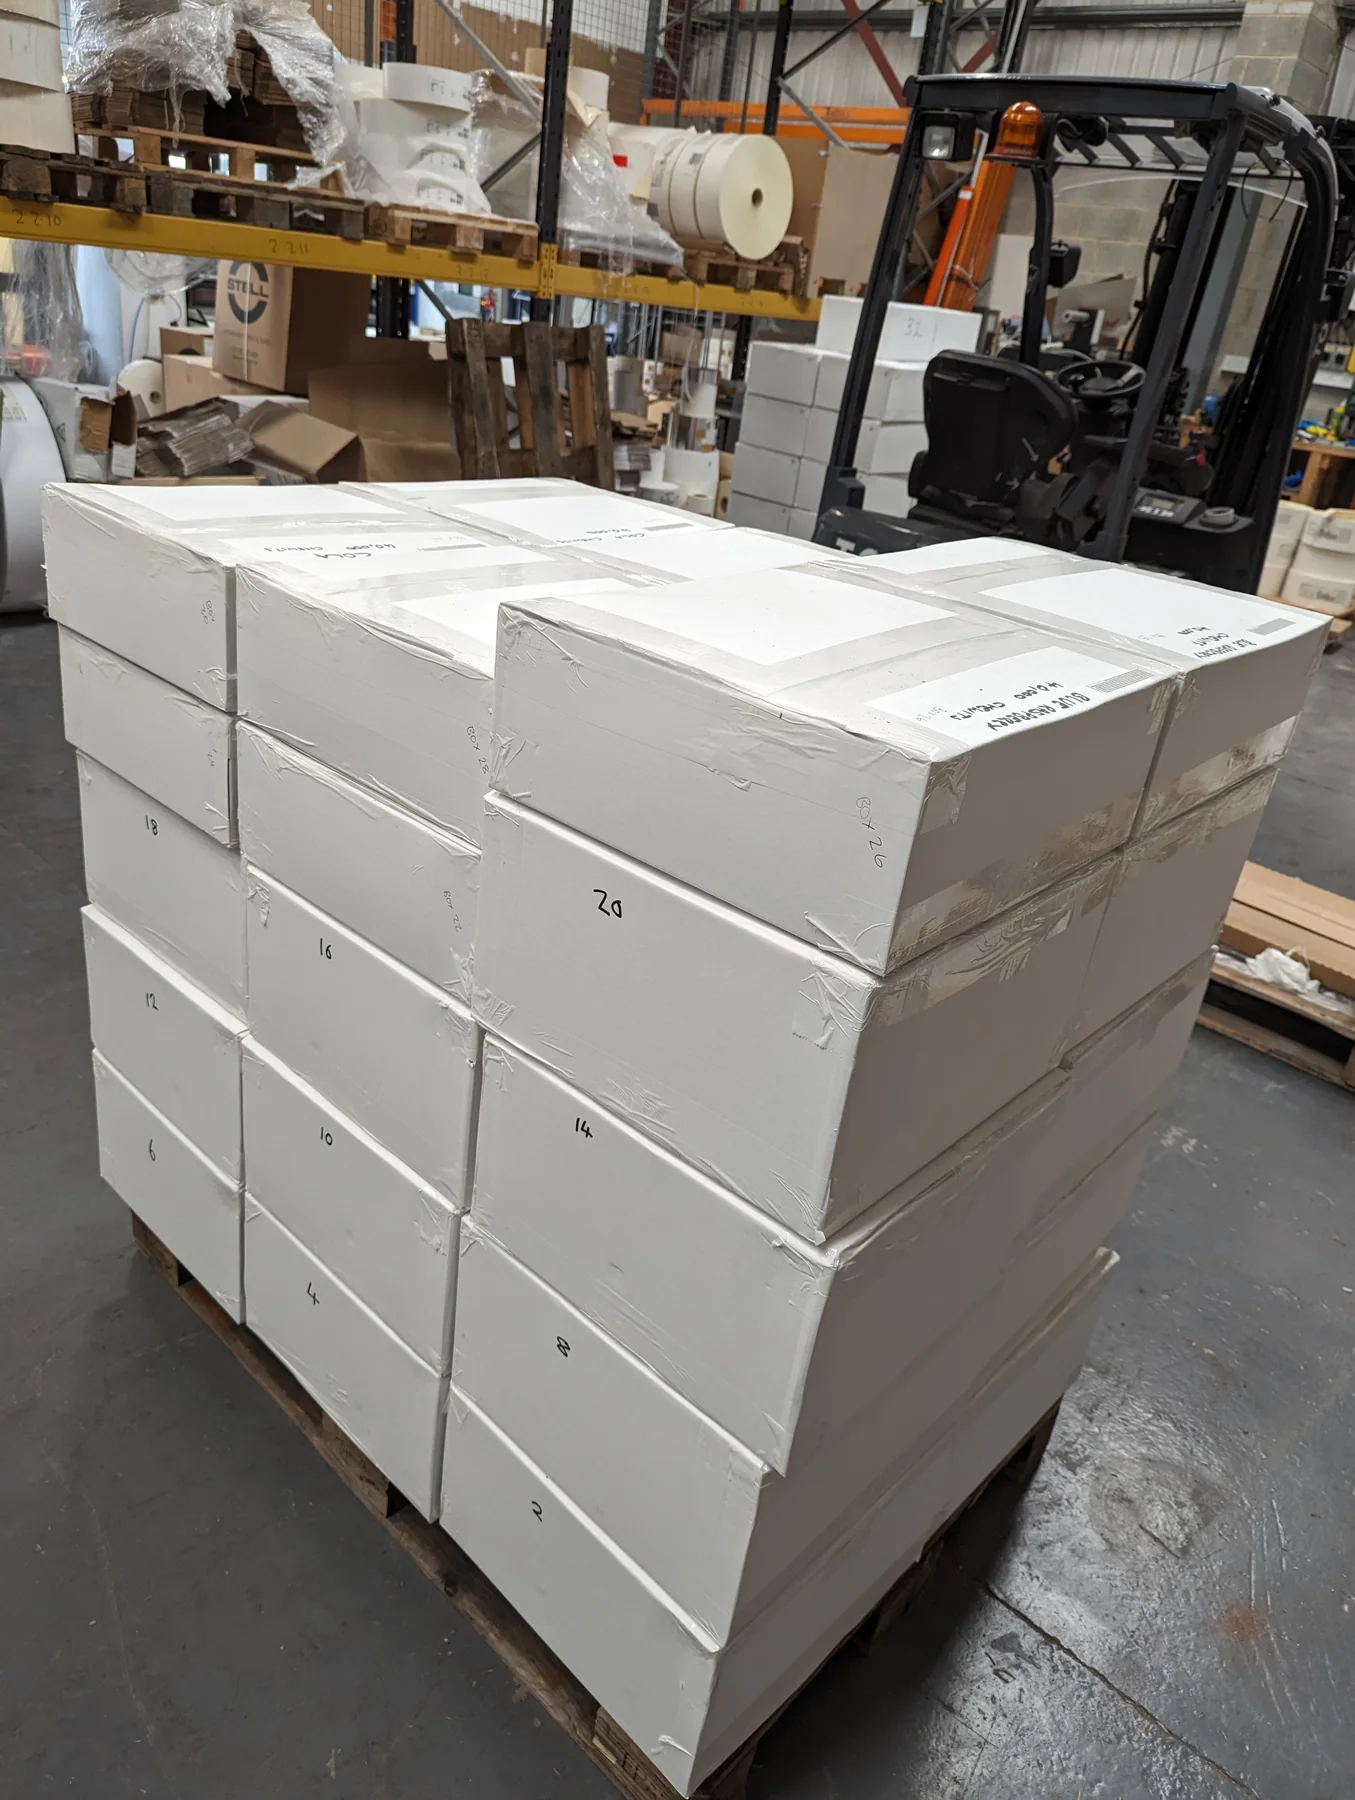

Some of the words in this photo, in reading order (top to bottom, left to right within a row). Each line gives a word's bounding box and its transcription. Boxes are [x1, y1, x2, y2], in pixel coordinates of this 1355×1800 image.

[313, 551, 372, 560] COLA
[345, 542, 397, 551] 40,000
[1013, 681, 1064, 700] 40,000
[1051, 692, 1092, 711] BLUE
[949, 701, 1006, 721] CHEWITS
[986, 703, 1052, 732] RASPBERRY
[145, 813, 159, 836] 18
[868, 836, 887, 869] 26
[592, 888, 623, 919] 20
[319, 937, 333, 960] 16
[145, 992, 159, 1011] 12
[320, 1126, 334, 1147] 10
[575, 1116, 594, 1139] 14
[148, 1138, 156, 1162] 6
[306, 1281, 321, 1306] 4
[556, 1335, 571, 1358] 8
[531, 1500, 543, 1523] 2
